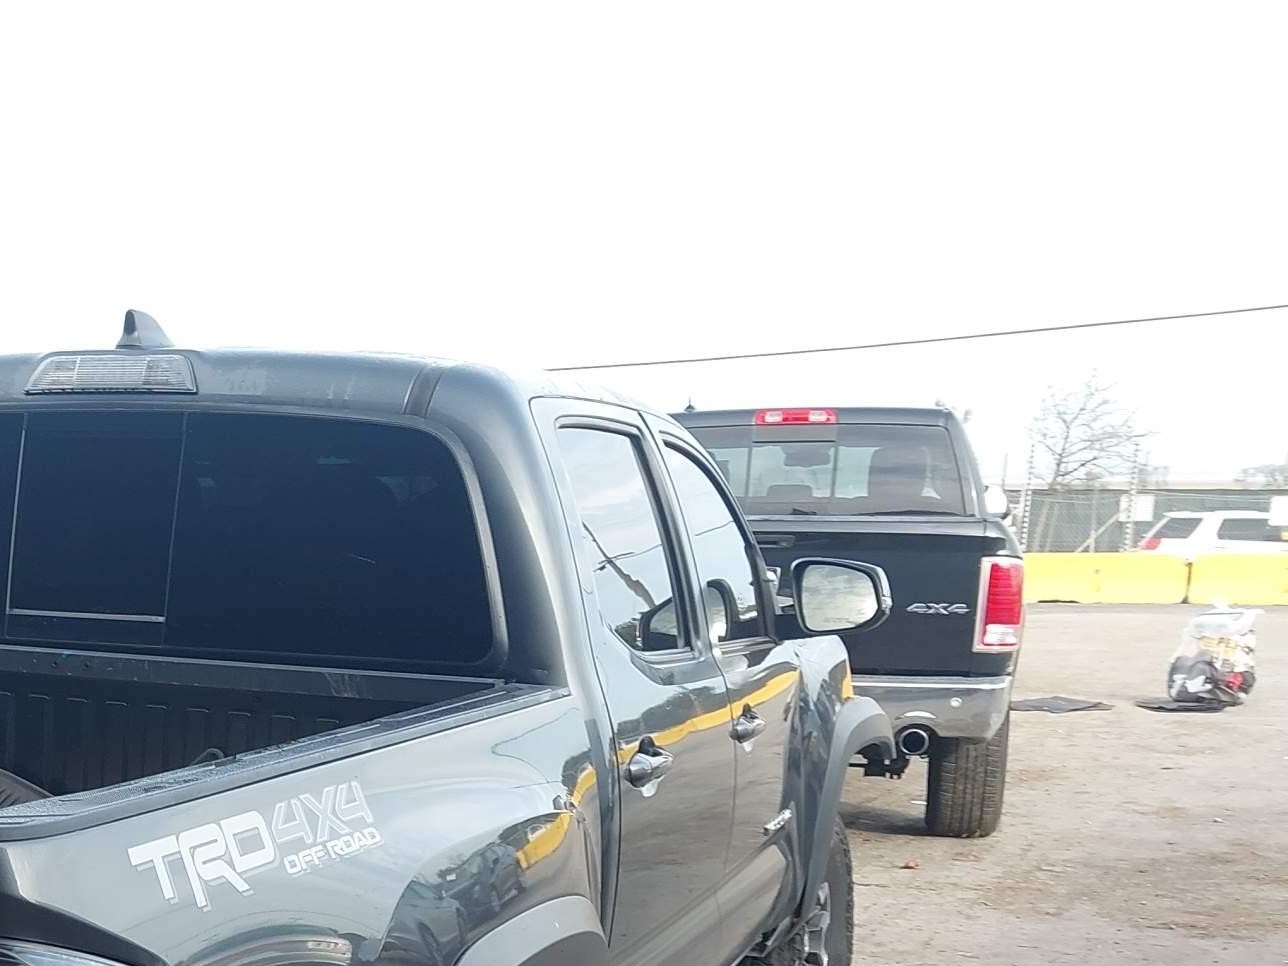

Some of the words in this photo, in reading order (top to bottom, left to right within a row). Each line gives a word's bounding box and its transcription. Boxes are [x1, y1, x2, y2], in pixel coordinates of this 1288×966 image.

[127, 810, 277, 909] TRD
[271, 780, 374, 845] 4X4
[283, 847, 328, 875] OFF
[328, 826, 383, 859] ROAD
